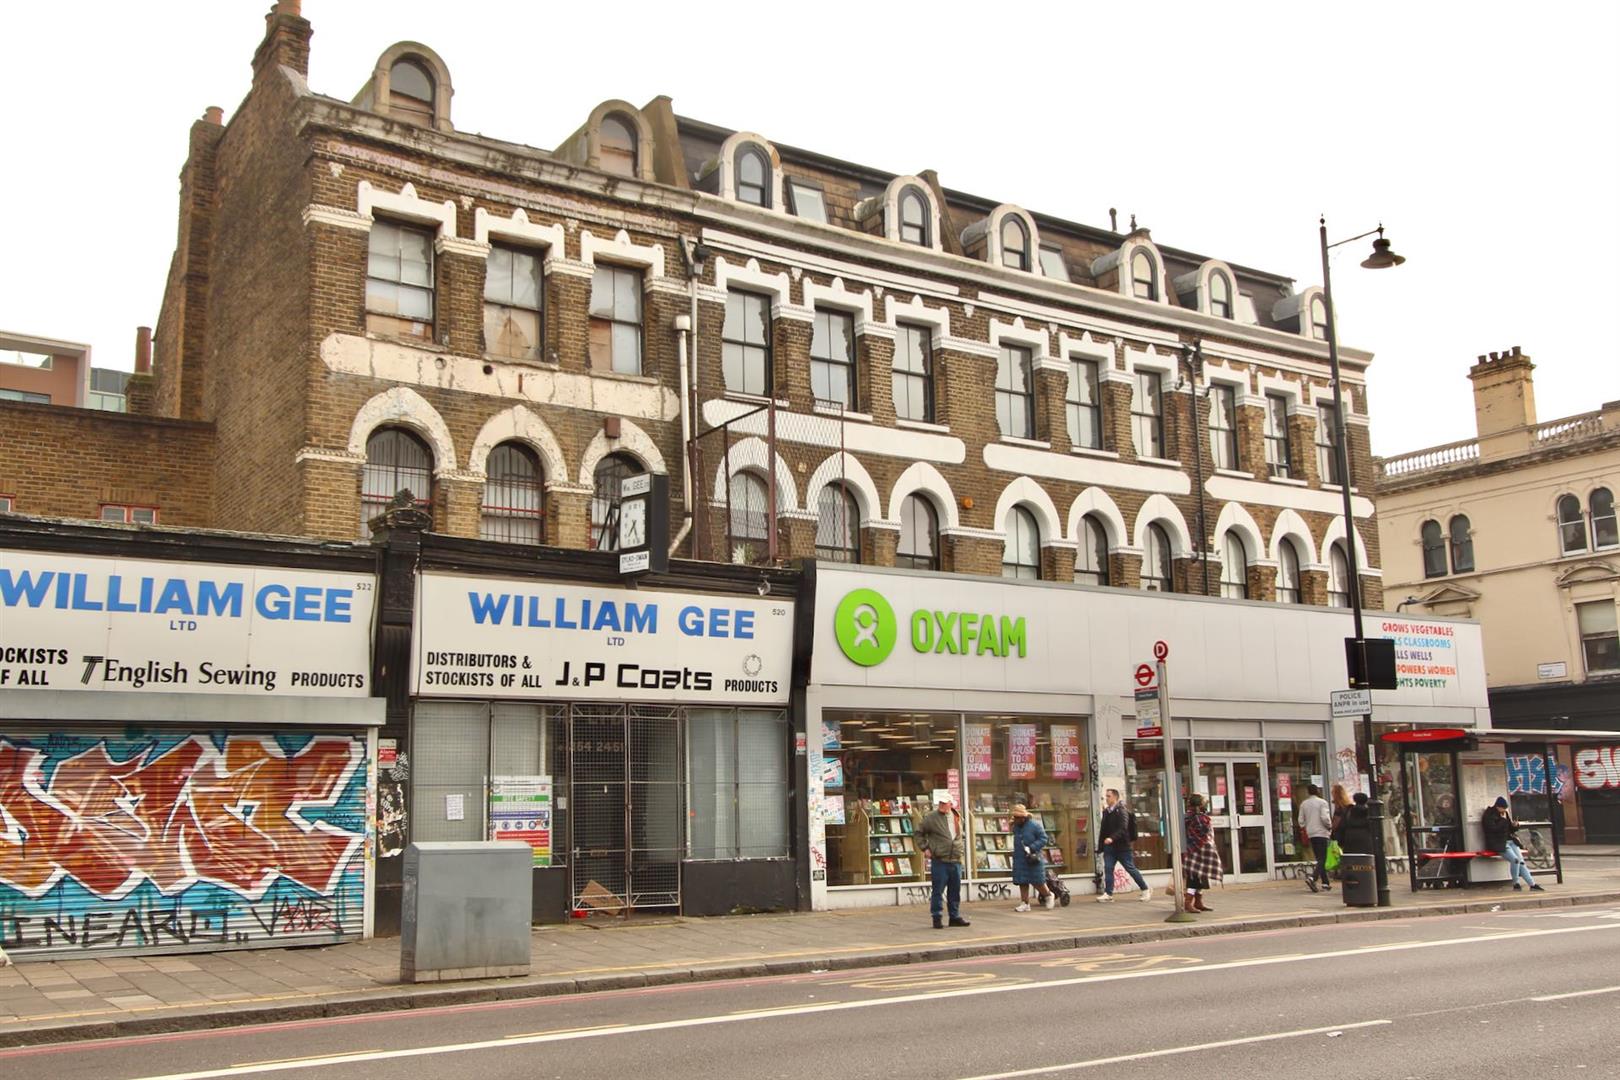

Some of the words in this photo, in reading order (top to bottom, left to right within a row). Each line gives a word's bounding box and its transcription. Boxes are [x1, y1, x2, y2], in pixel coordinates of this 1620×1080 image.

[356, 583, 372, 591] 522
[0, 569, 243, 617] WILLIAM
[255, 584, 353, 623] GEE
[468, 592, 658, 634] WILLIAM
[678, 605, 755, 639] GEE
[772, 608, 786, 616] 520
[169, 620, 197, 631] LTD
[1382, 622, 1409, 633] GROWS
[1410, 624, 1453, 636] VEGETABLES
[911, 609, 1027, 658] OXFAM
[607, 637, 625, 646] LTD
[1403, 637, 1451, 648] CLASSROOMS
[1156, 643, 1166, 656] D
[1410, 651, 1432, 661] WELLS
[427, 652, 517, 668] DISTRIBUTORS
[522, 655, 532, 669] &
[18, 669, 49, 685] ALL
[104, 659, 188, 688] English
[198, 661, 276, 692] Sewing
[617, 663, 712, 690] Coats
[1397, 664, 1426, 675] POWERS
[1427, 666, 1456, 676] WOMEN
[291, 672, 364, 688] PRODUCTS
[426, 671, 494, 686] STOCKISTS
[501, 674, 515, 687] OF
[521, 675, 542, 688] ALL
[725, 679, 778, 693] PRODUCTS
[1415, 679, 1447, 689] POVERTY
[1339, 692, 1361, 700] POLICE
